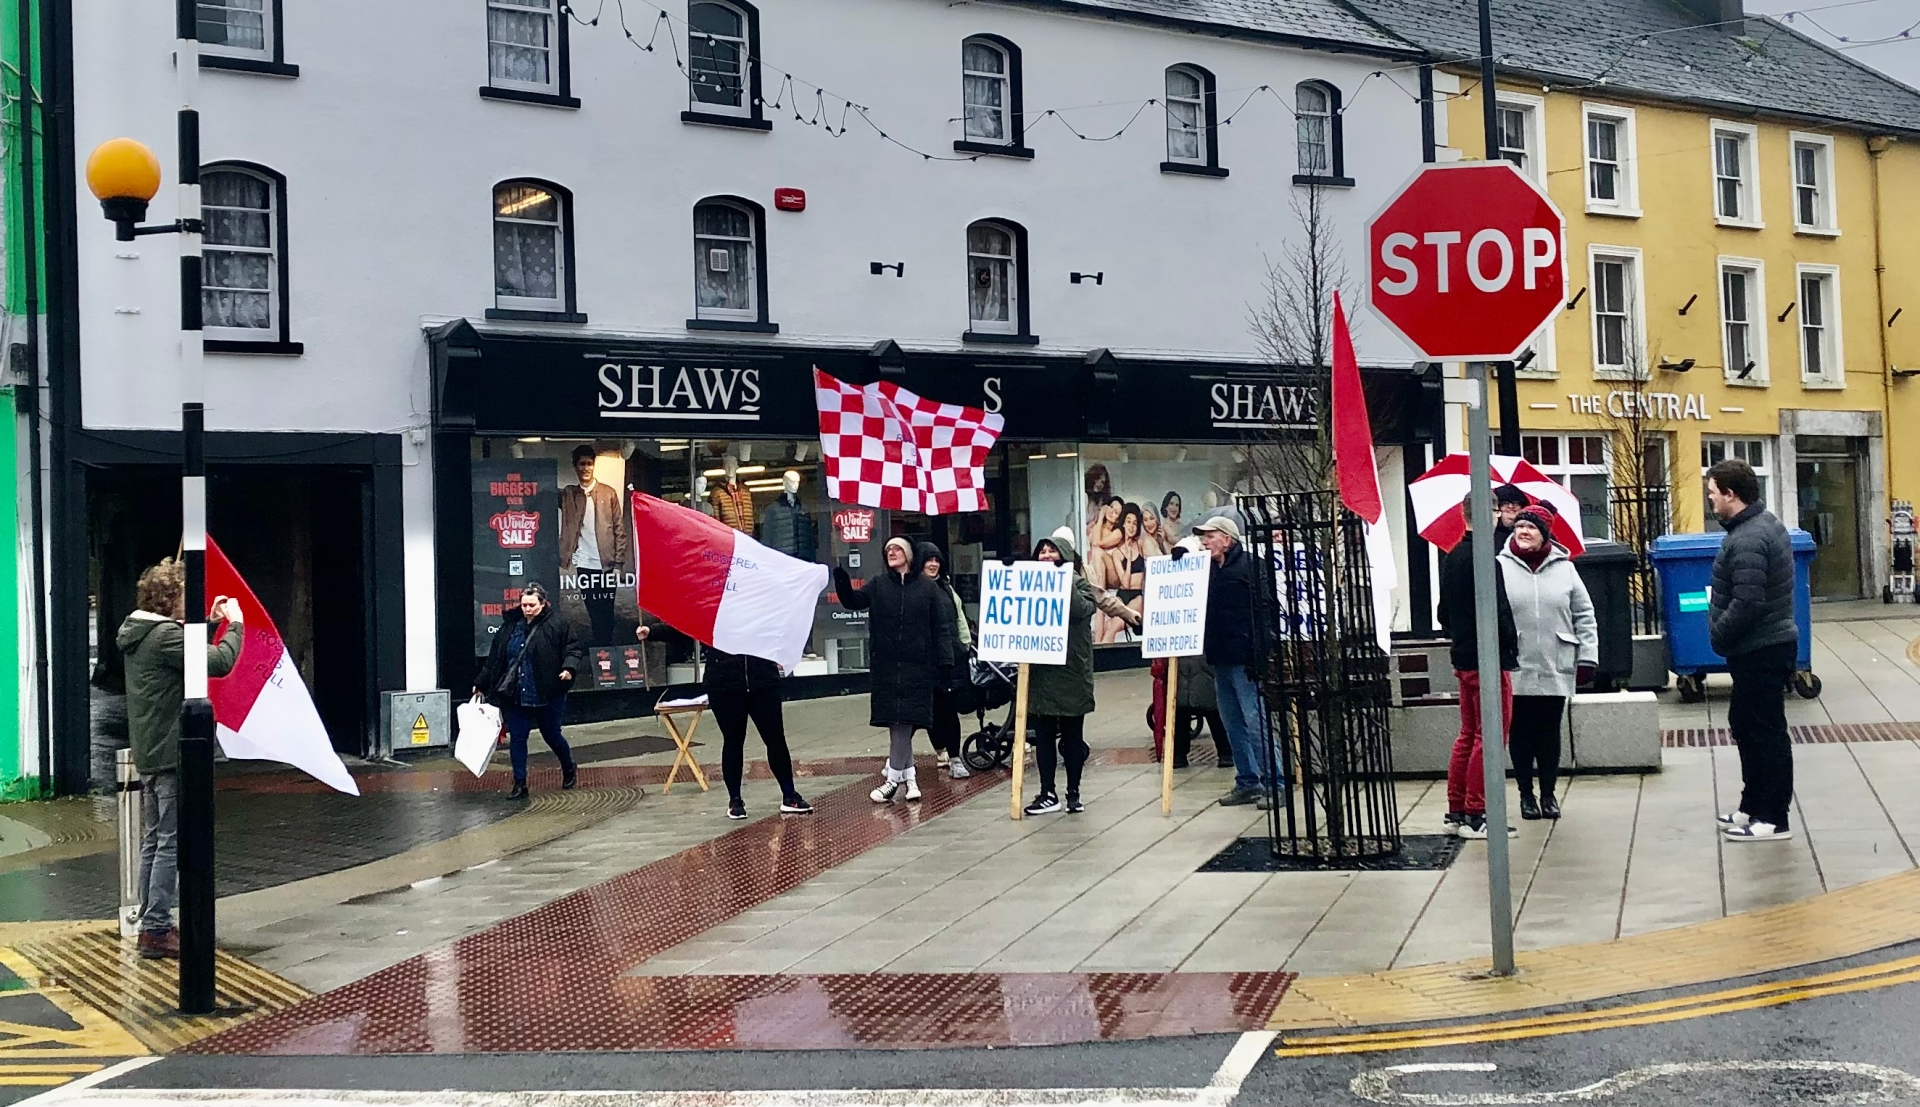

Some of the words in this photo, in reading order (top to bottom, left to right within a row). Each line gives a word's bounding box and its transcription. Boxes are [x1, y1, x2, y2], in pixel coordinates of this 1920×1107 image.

[1378, 228, 1557, 296] STOP
[598, 363, 761, 411] SHAWS
[1210, 383, 1319, 422] SHAWS
[1568, 394, 1602, 413] THE
[1607, 390, 1712, 420] CENTRAL
[490, 482, 538, 496] BIGGEST
[492, 514, 537, 530] Winter
[835, 511, 872, 527] Winter
[502, 530, 533, 544] SALE
[843, 527, 869, 540] SALE
[1151, 556, 1206, 575] GOVERNMENT
[988, 569, 1013, 590] WE
[1019, 570, 1066, 592] WANT
[1159, 583, 1194, 600] POLICIES
[985, 596, 1064, 627] ACTION
[1150, 610, 1180, 626] FAILING
[1183, 609, 1198, 623] THE
[983, 634, 1005, 649] NOT
[1008, 635, 1064, 652] PROMISES
[1146, 637, 1167, 652] IRISH
[1169, 635, 1198, 651] PEOPLE
